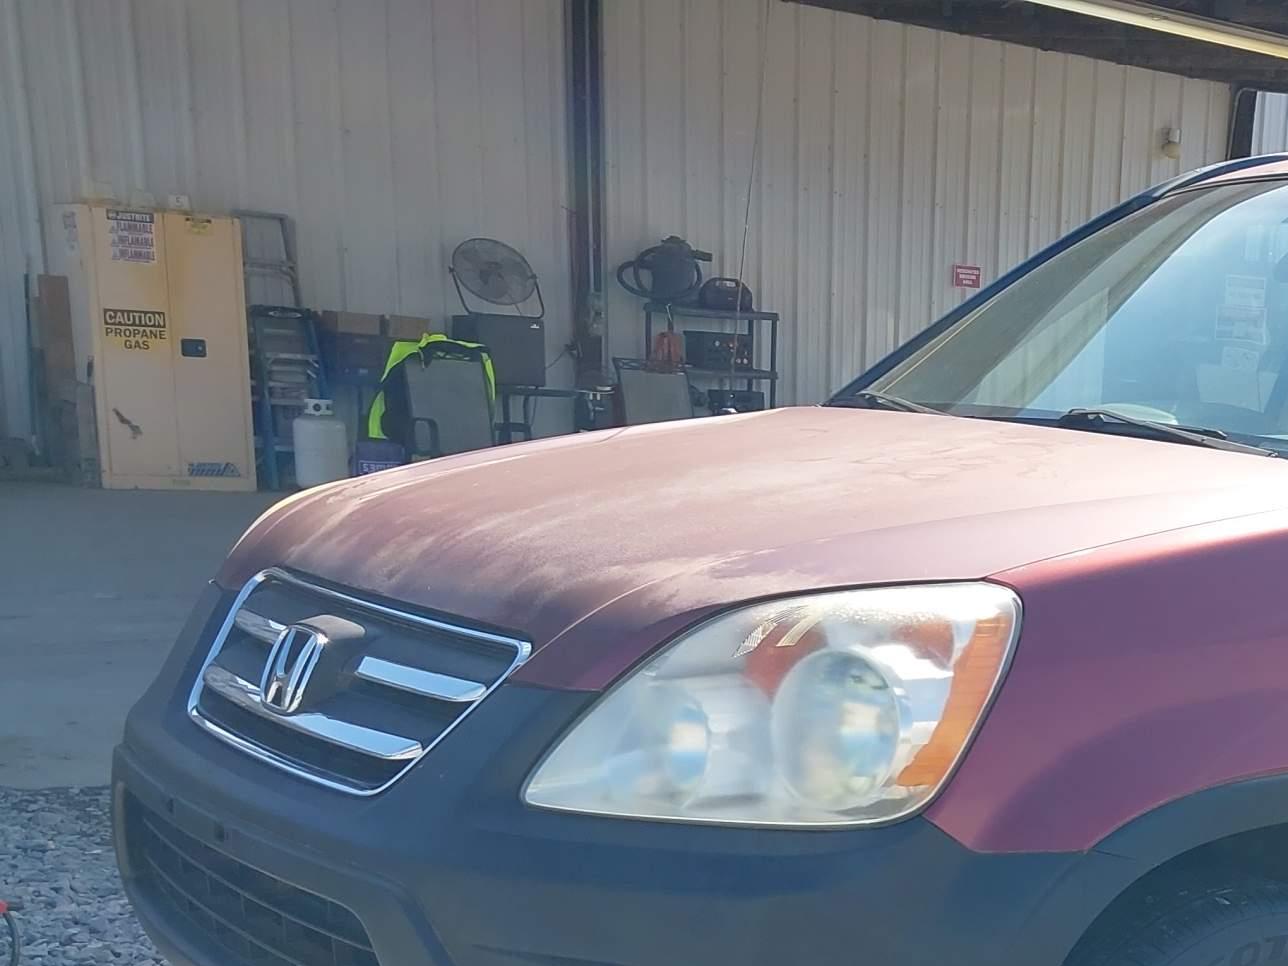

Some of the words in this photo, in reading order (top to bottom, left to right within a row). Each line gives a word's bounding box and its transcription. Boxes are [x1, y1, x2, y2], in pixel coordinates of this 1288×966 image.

[105, 310, 164, 327] CAUTION
[105, 327, 167, 340] PROPANE
[124, 340, 150, 350] GAS
